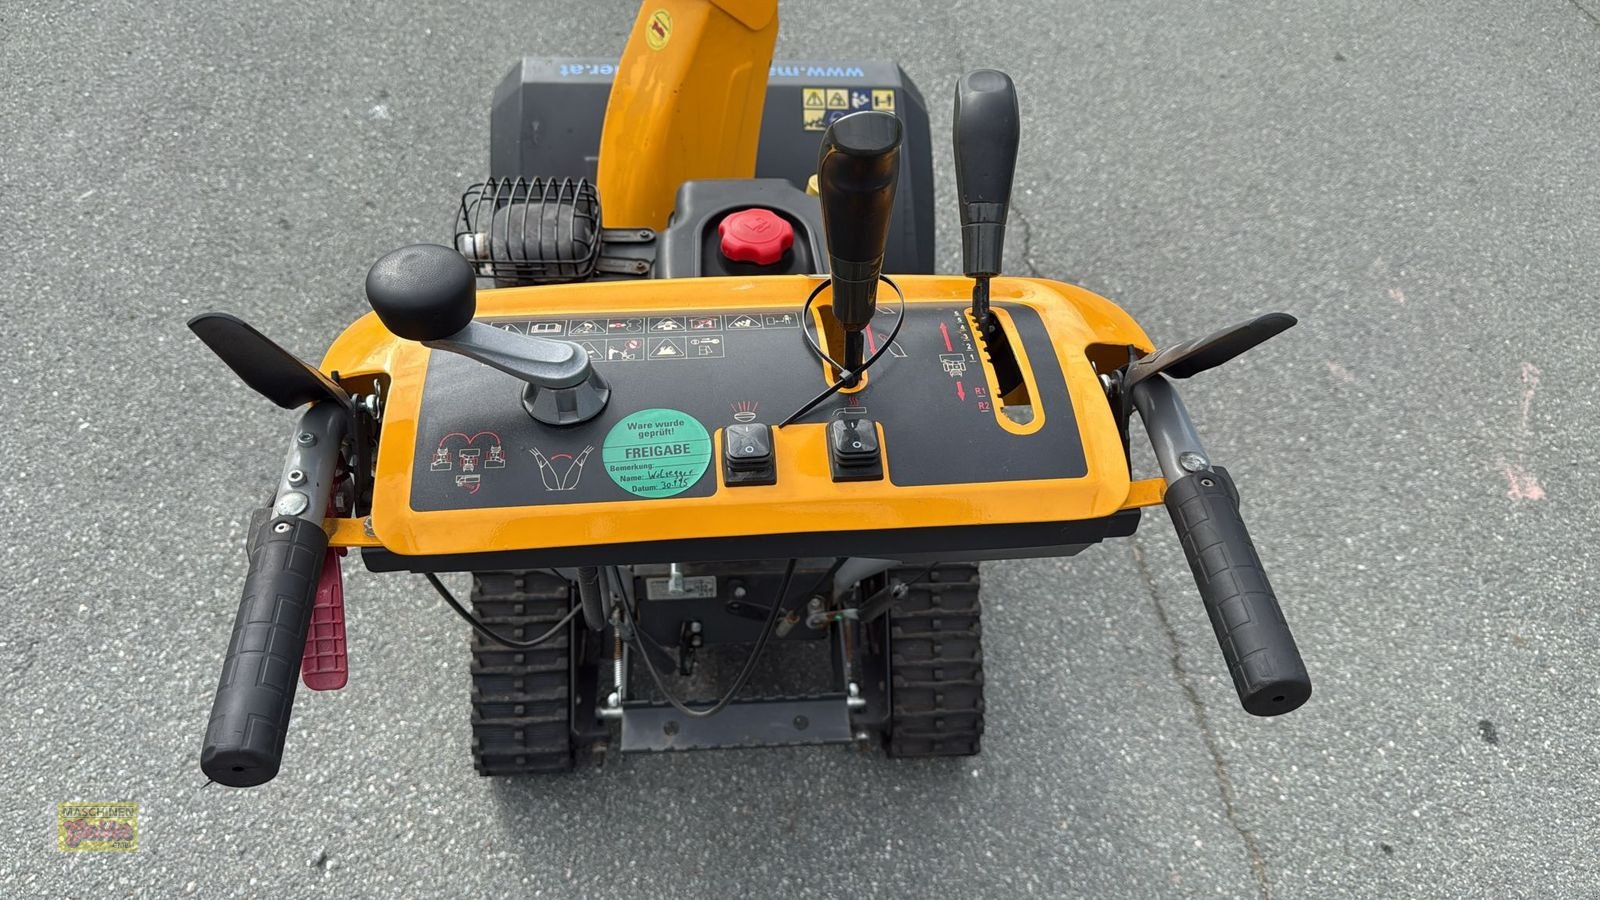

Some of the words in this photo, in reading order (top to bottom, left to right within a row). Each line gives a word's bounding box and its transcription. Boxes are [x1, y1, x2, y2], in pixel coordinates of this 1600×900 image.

[975, 387, 986, 395] R1
[978, 401, 990, 410] R2
[627, 422, 653, 430] Ware
[655, 419, 685, 428] wurde
[638, 427, 675, 439] geprüft!
[625, 444, 691, 459] FREIGABE
[609, 463, 655, 472] Bemerkung:
